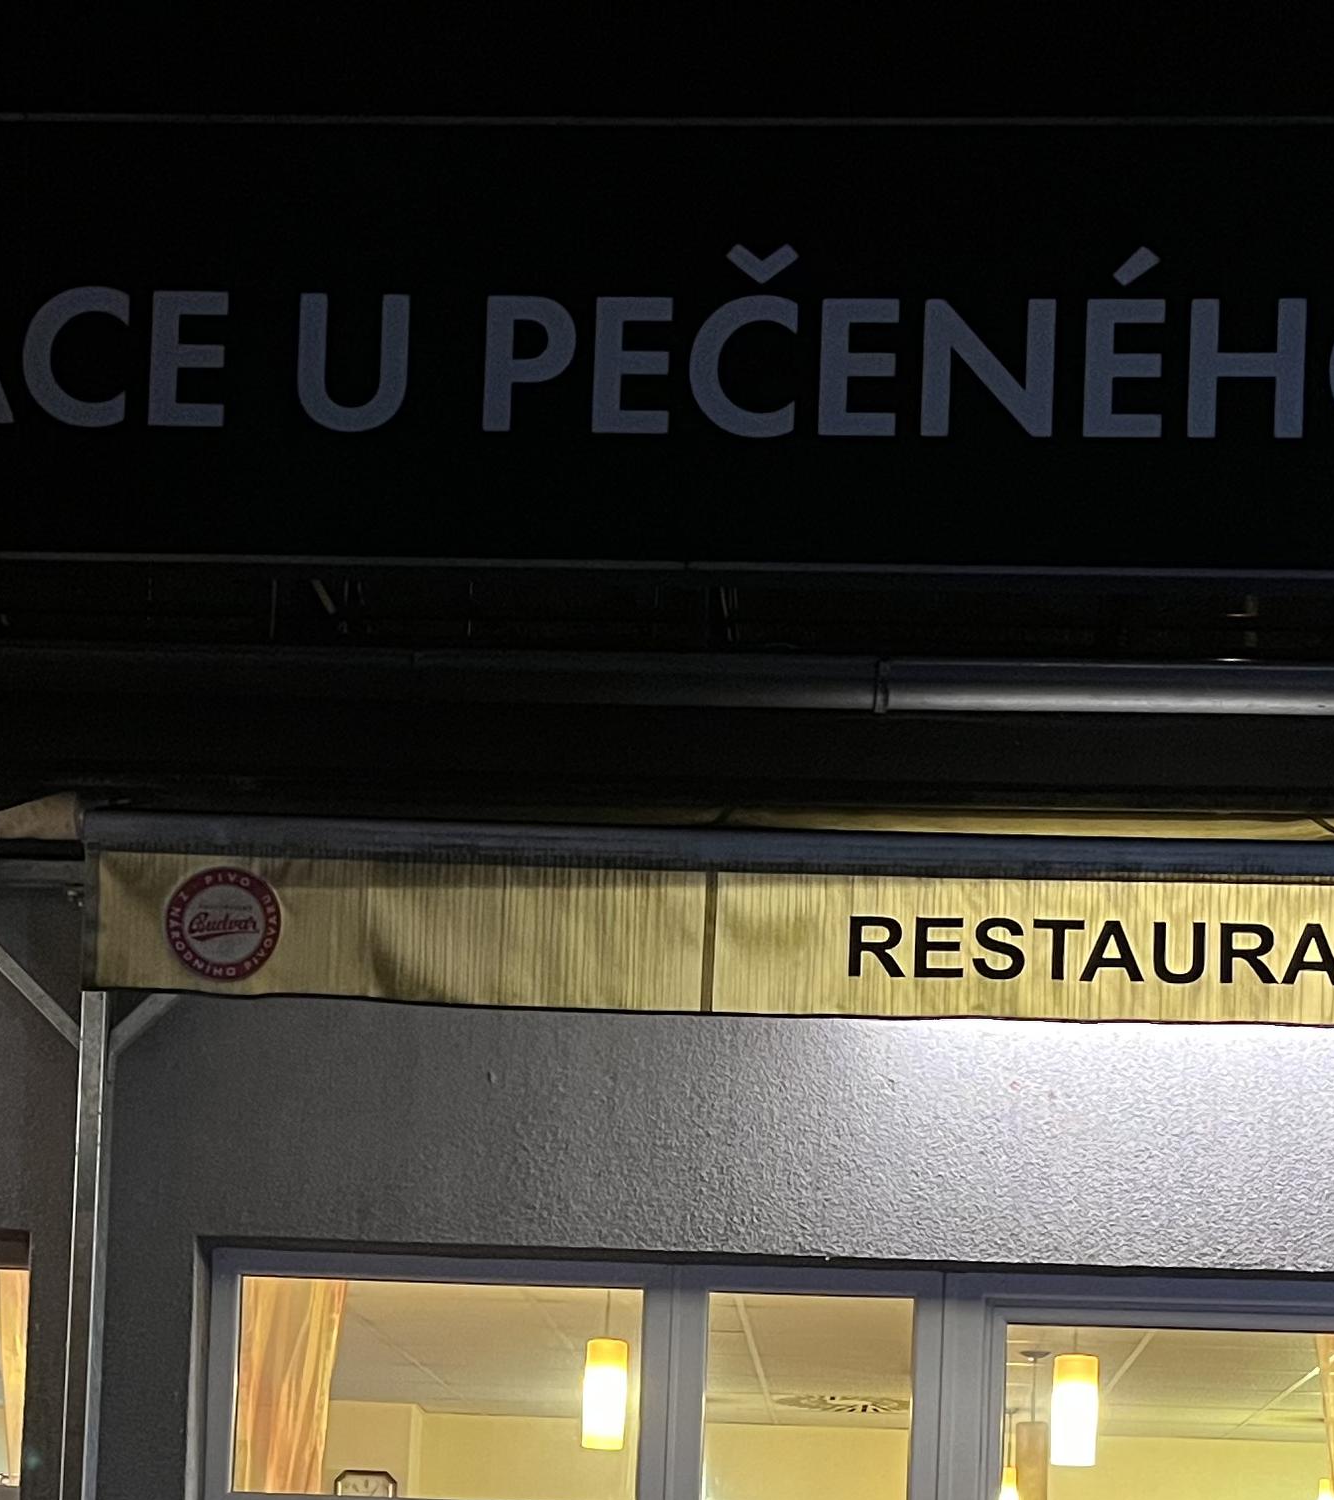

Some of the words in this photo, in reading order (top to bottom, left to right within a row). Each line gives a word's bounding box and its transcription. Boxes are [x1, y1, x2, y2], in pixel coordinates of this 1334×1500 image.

[296, 291, 411, 434] U
[205, 871, 251, 887] PIVO
[188, 911, 260, 941] Budvar
